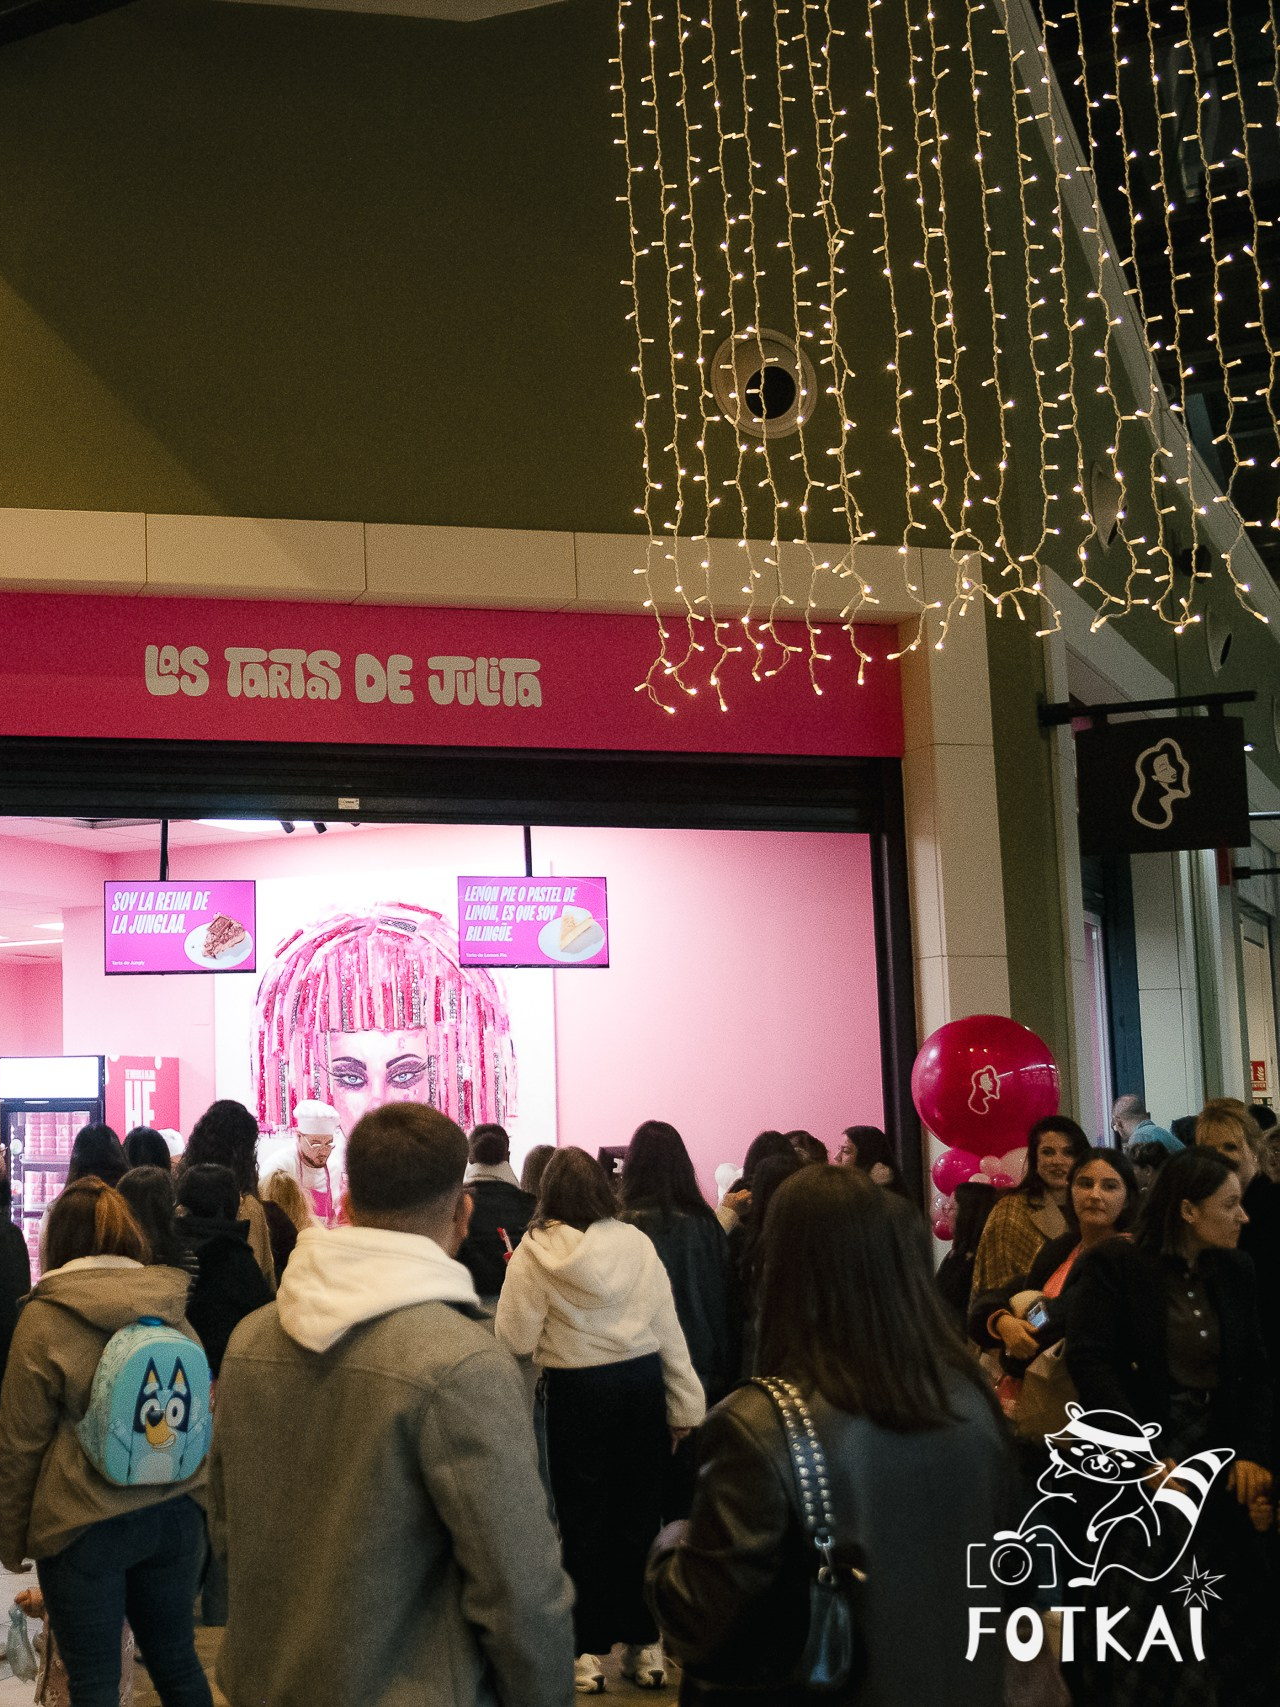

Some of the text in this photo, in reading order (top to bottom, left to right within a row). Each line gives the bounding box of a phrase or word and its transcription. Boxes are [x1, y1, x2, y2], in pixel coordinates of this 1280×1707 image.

[355, 653, 415, 705] DE
[111, 891, 211, 911] SOY LA REINA DE
[464, 886, 499, 902] LEMON
[500, 886, 517, 902] PIE
[527, 886, 562, 902] PASTEL
[563, 886, 577, 902] DE
[111, 914, 129, 934] LA
[501, 905, 515, 921] ES
[516, 905, 536, 923] QUE
[536, 905, 558, 921] SOY
